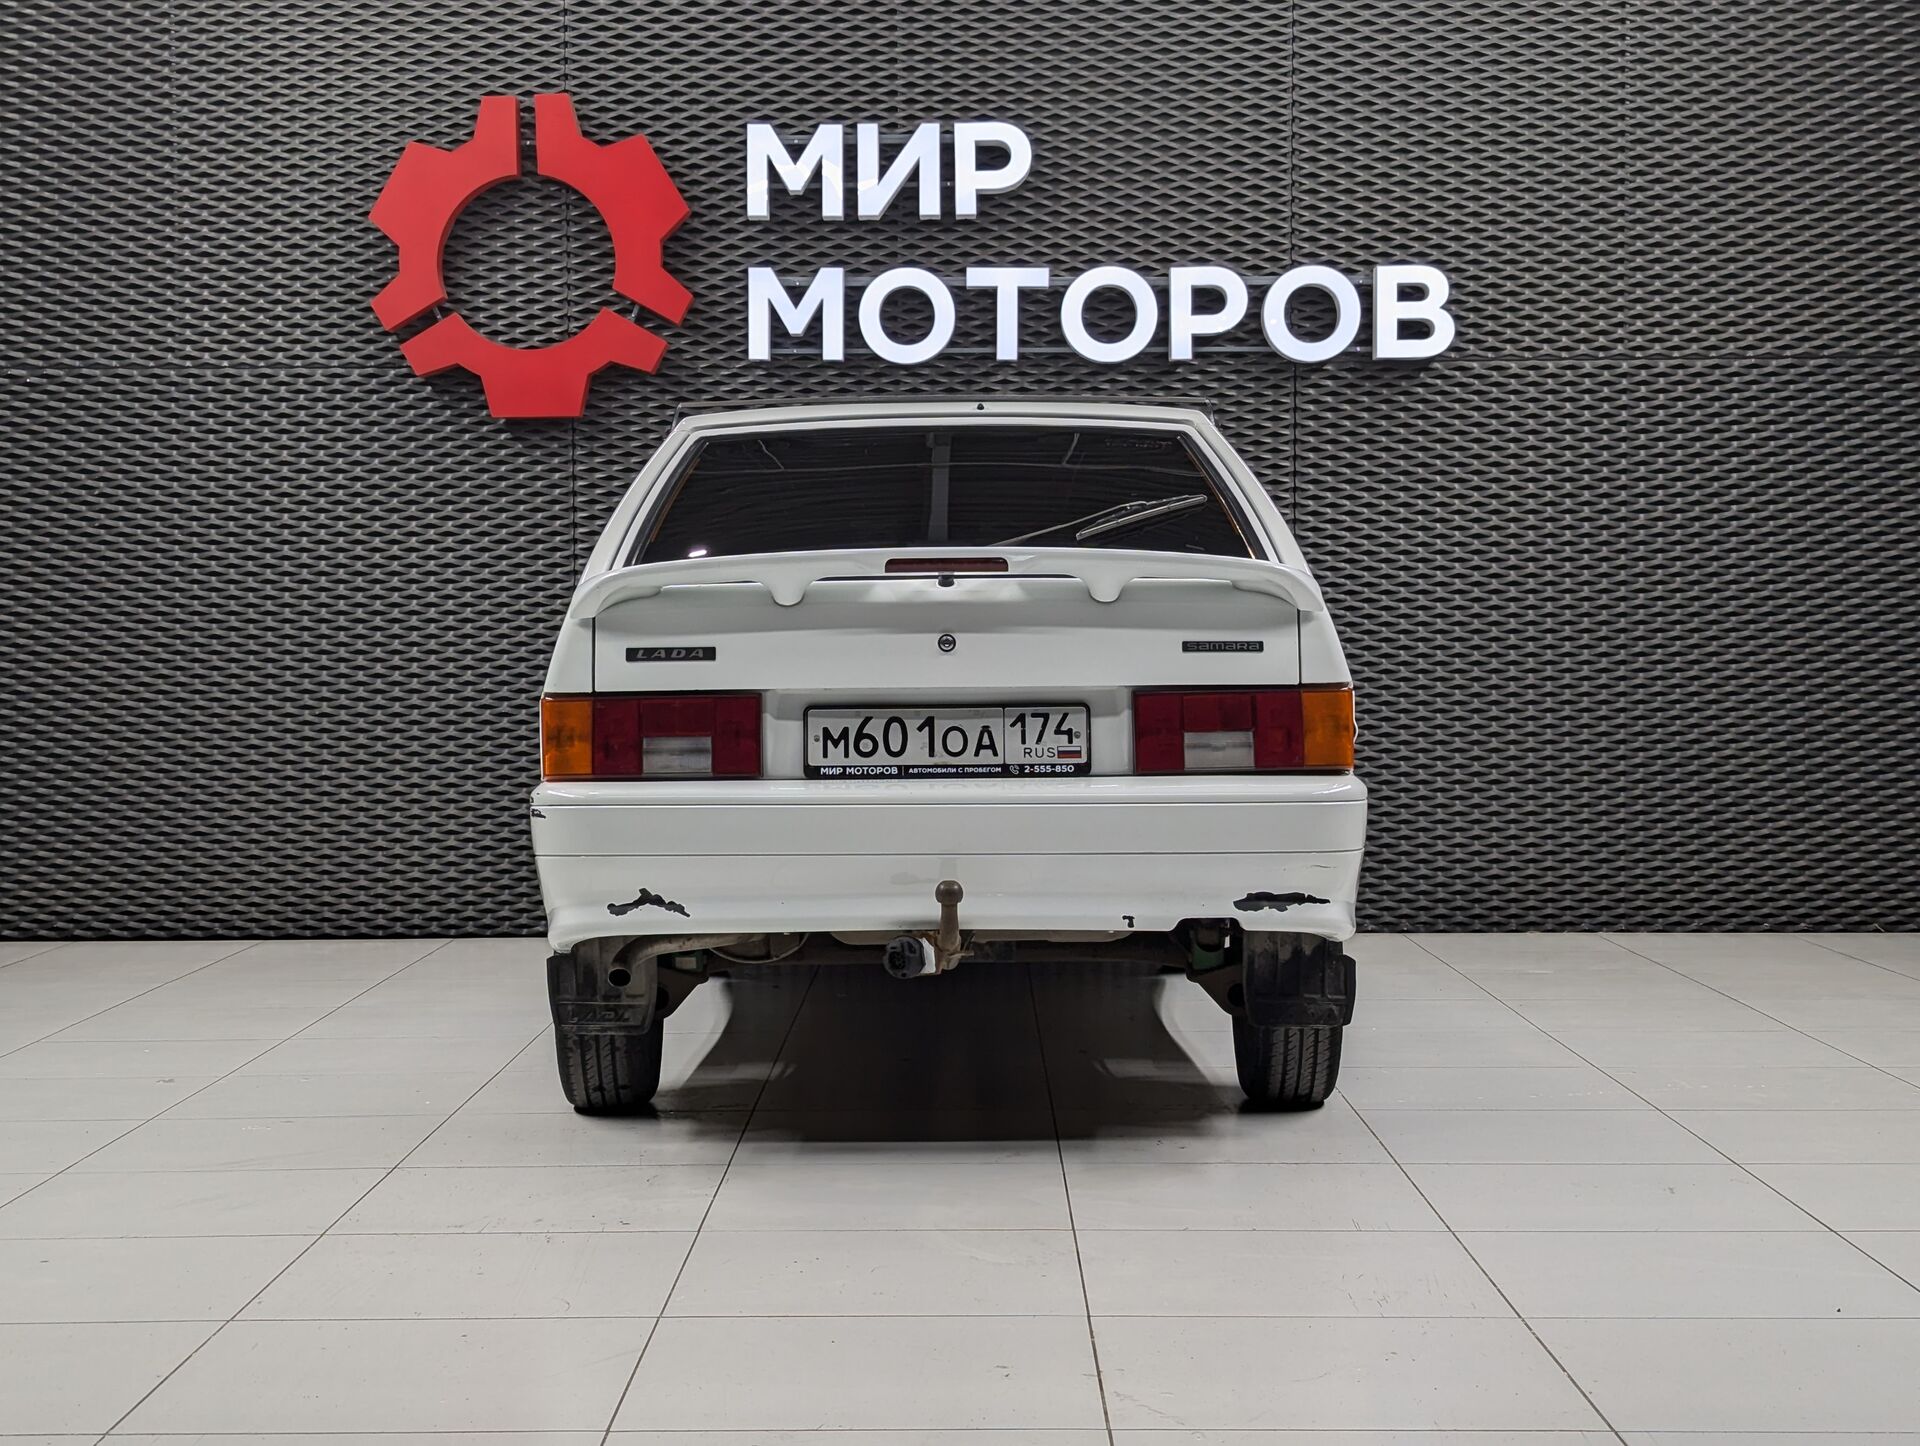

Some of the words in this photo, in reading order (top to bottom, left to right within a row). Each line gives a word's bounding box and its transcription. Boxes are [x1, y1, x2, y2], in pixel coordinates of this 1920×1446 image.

[746, 121, 1033, 221] МИР
[746, 264, 1457, 365] МОТОРОВ
[636, 648, 704, 659] LADA
[1009, 712, 1074, 746] 174
[1023, 746, 1056, 759] RUS
[820, 766, 843, 775] МИР
[846, 766, 898, 775] МОТОРОВ
[1024, 764, 1075, 773] 2-555-850
